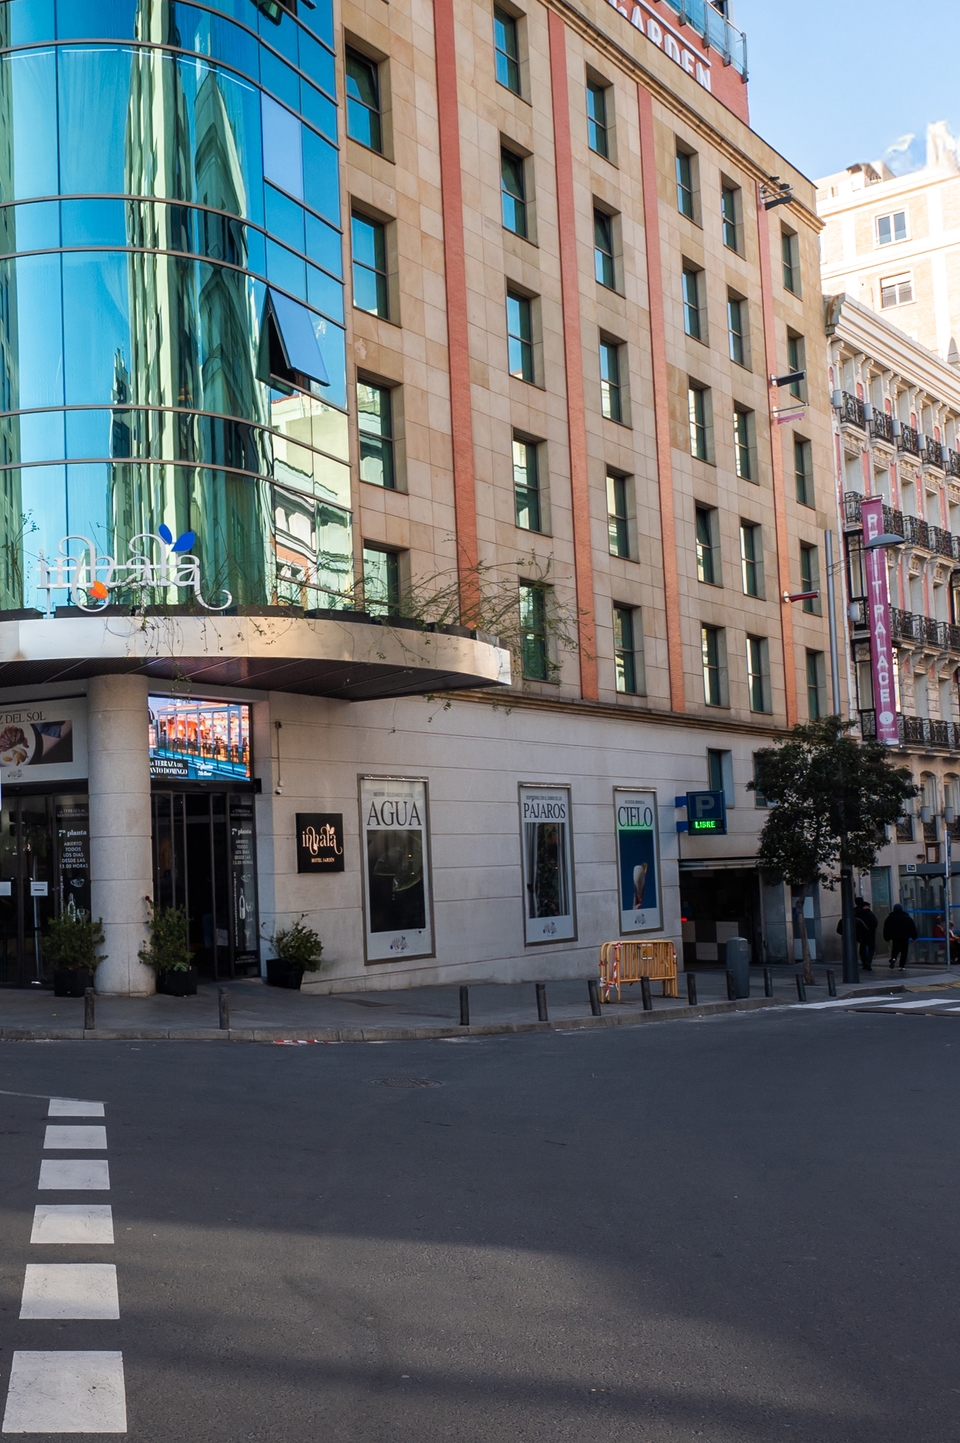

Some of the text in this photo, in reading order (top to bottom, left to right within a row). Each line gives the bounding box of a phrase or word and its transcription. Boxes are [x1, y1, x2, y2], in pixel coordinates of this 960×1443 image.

[38, 524, 233, 613] inhala
[874, 605, 890, 702] PALACE
[5, 713, 25, 724] DEL
[26, 711, 46, 722] SOL
[155, 759, 177, 767] TERRAZA
[164, 767, 188, 775] DOMINGO
[366, 800, 422, 826] AGUA
[523, 798, 566, 819] PÁJAROS
[618, 806, 653, 827] CIELO
[695, 795, 715, 818] P
[67, 829, 87, 837] planta
[695, 820, 716, 829] LIBRE
[302, 823, 343, 856] inhala
